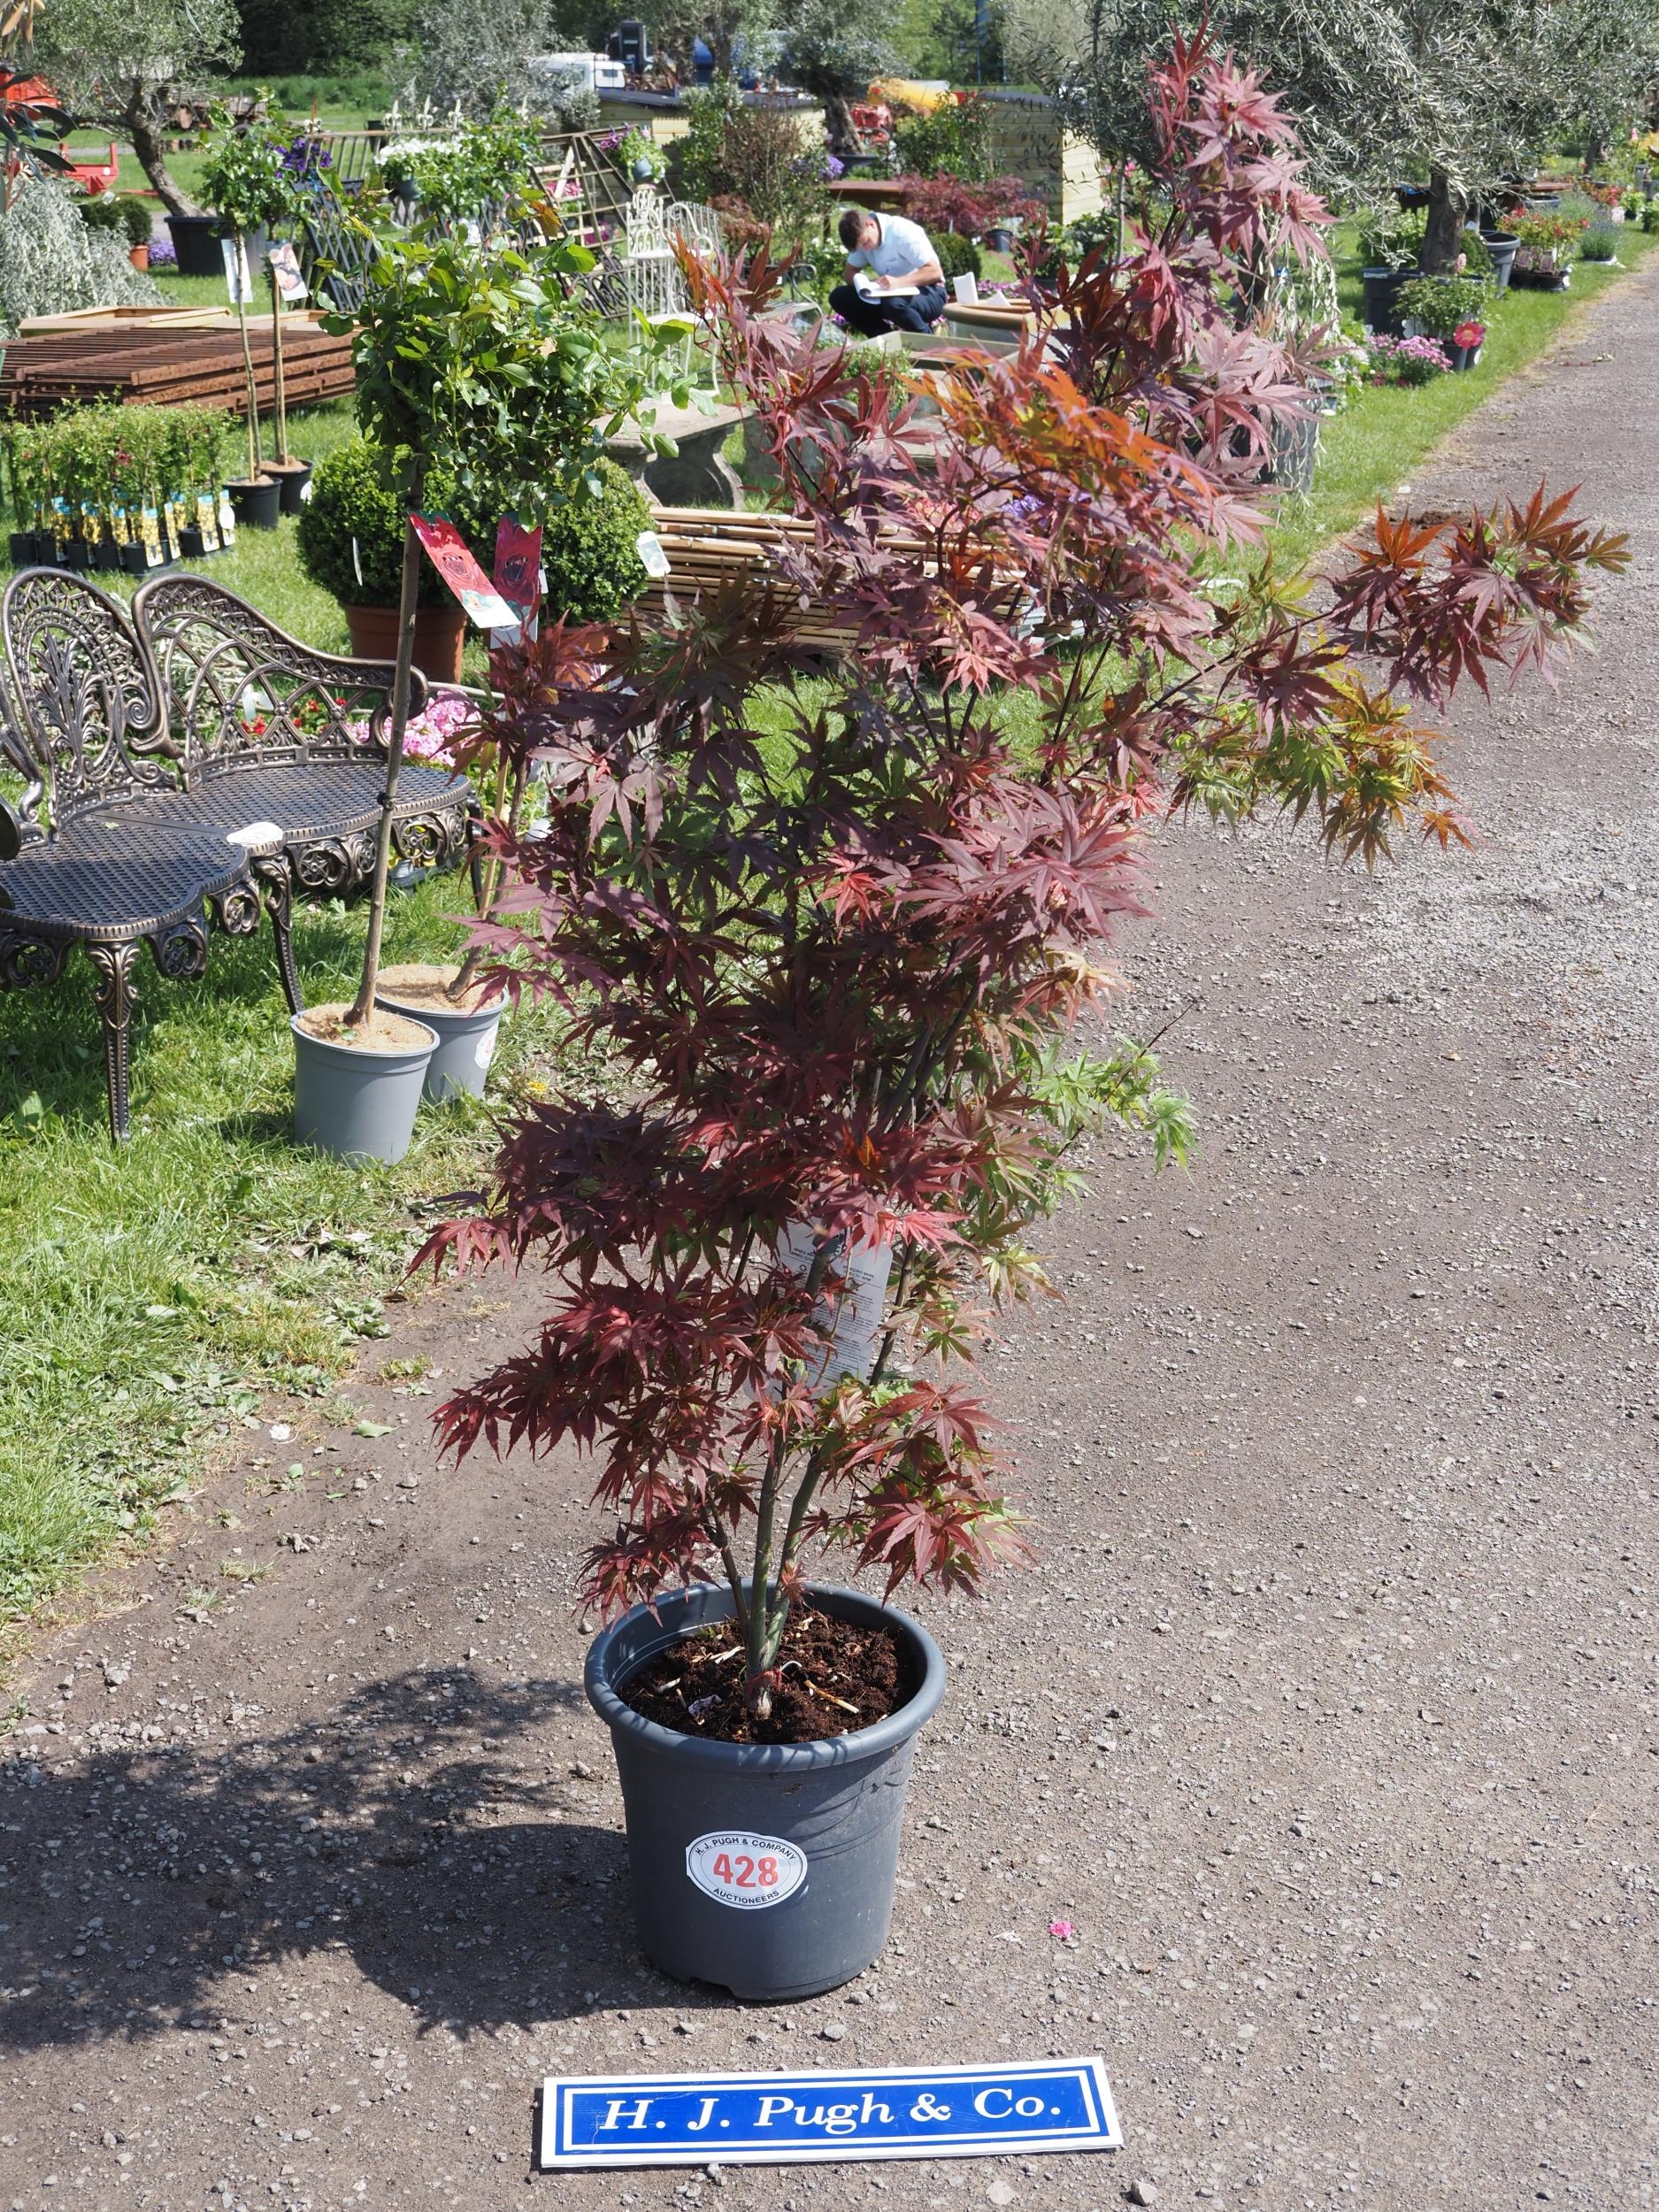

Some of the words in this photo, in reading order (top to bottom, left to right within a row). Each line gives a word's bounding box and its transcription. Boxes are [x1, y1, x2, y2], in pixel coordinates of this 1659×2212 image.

[712, 1837, 739, 1846] PUGH
[752, 1839, 796, 1861] COMPANY
[713, 1854, 779, 1887] 428
[713, 1888, 780, 1904] AUCTIONEERS
[600, 2099, 666, 2131] H.
[687, 2097, 730, 2131] J.
[753, 2091, 894, 2133] Pugh
[910, 2093, 951, 2122] &
[973, 2087, 1062, 2119] Co.
